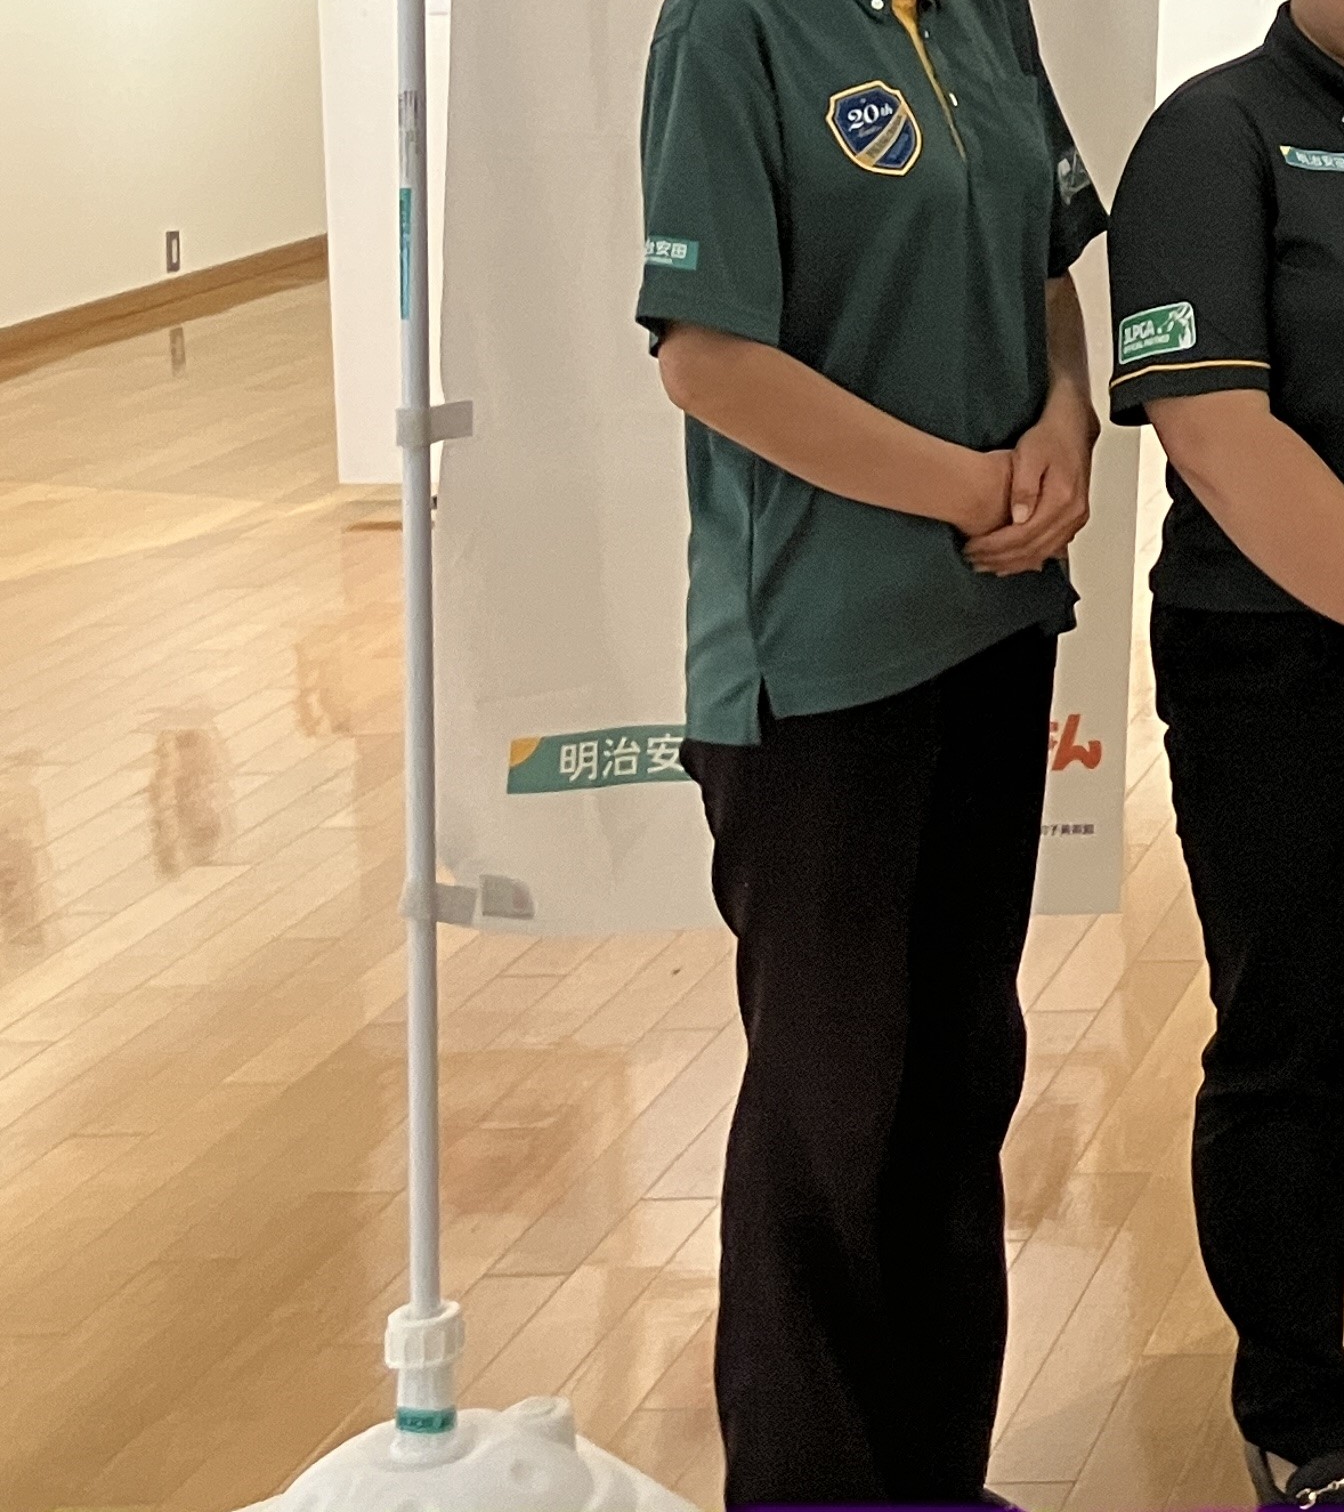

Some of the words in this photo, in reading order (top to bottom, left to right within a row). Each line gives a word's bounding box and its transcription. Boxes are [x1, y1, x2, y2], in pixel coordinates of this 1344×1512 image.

[847, 103, 894, 132] 20th
[559, 733, 686, 782] 明治安
[1049, 713, 1103, 771] ん
